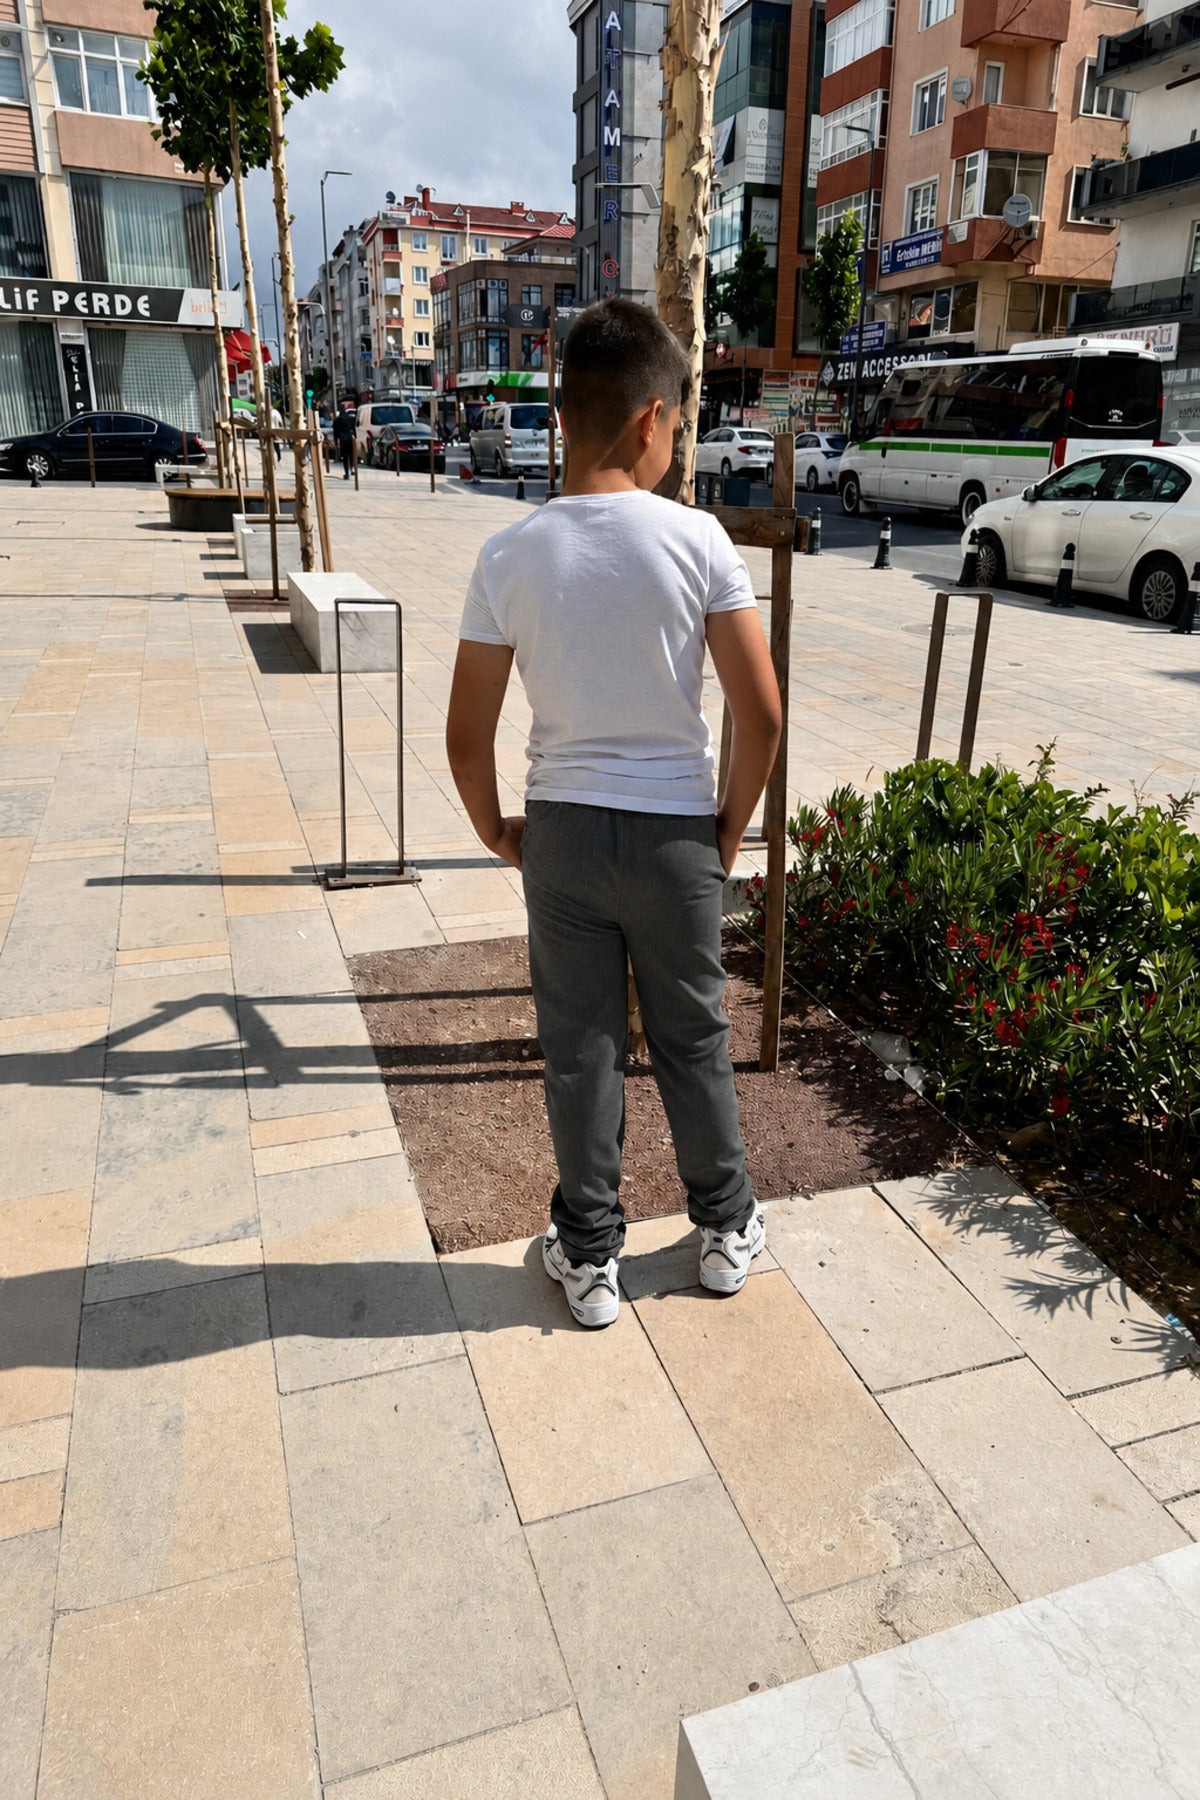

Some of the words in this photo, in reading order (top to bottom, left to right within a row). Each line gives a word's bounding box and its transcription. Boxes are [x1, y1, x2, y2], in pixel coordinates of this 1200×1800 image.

[603, 10, 621, 221] ATAMER
[52, 290, 151, 317] PERDE
[837, 361, 858, 380] ZEN
